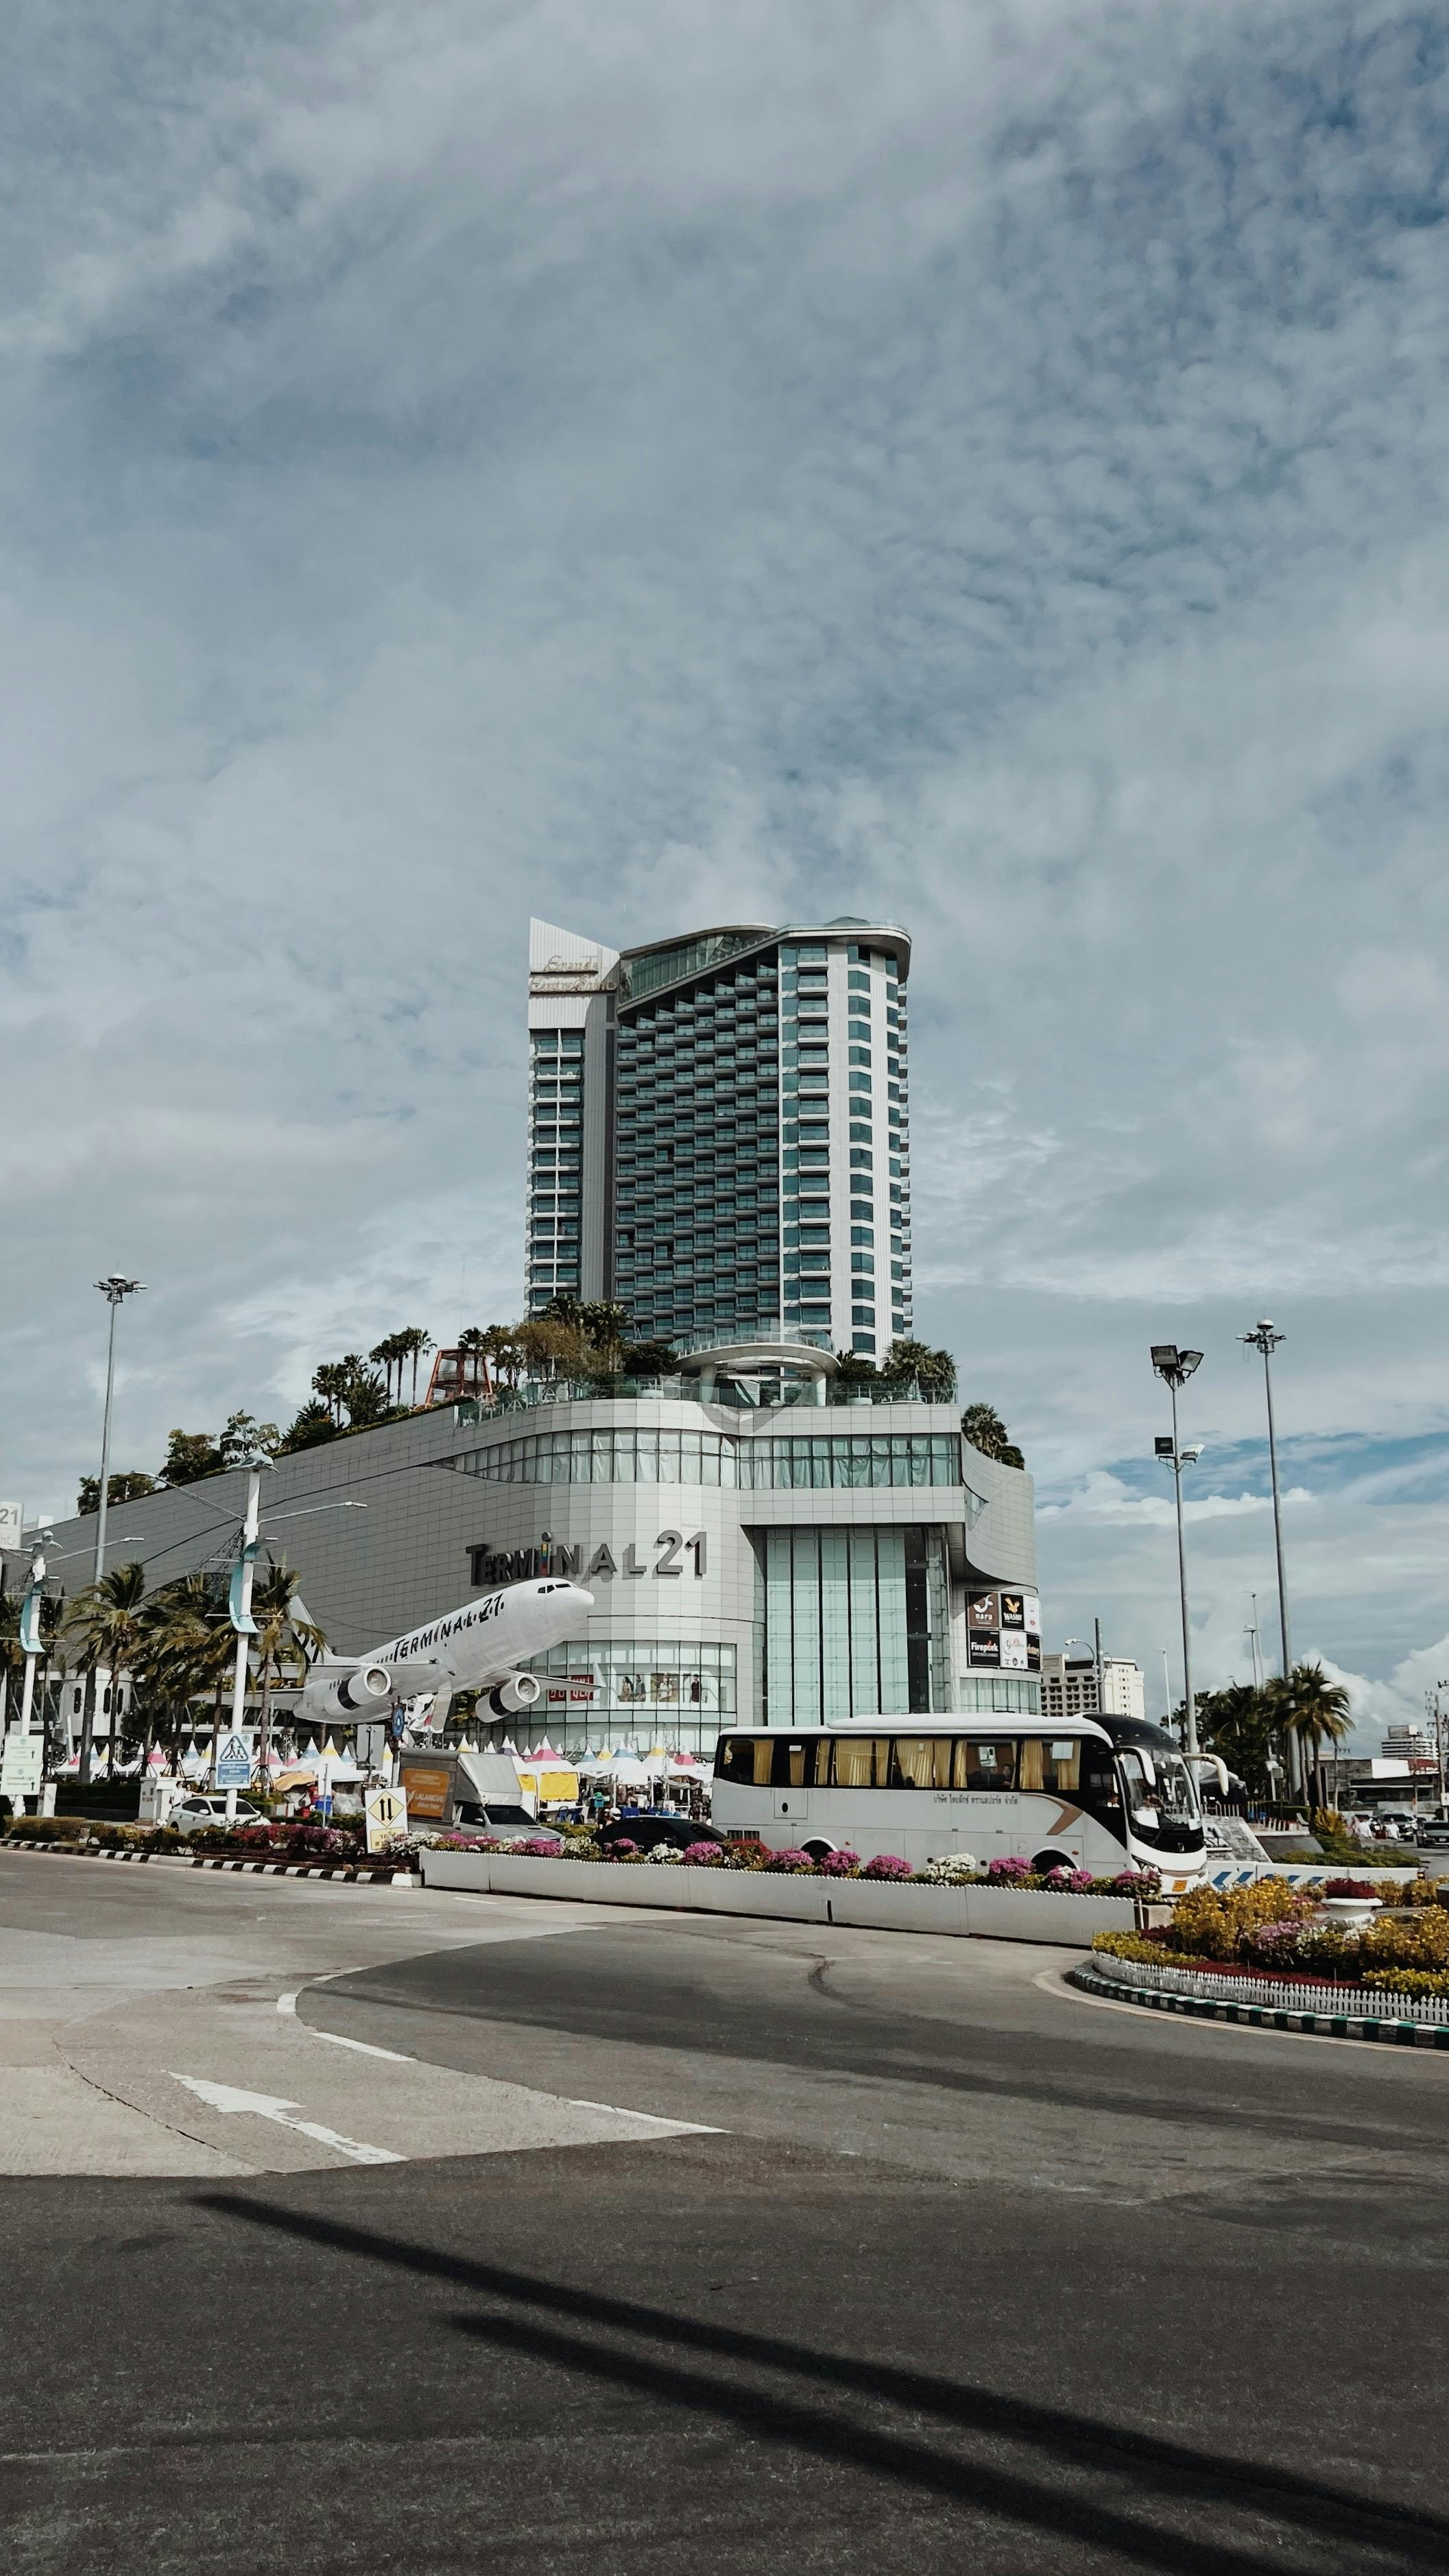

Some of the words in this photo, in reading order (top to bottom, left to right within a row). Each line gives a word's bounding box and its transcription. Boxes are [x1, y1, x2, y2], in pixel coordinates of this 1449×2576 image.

[0, 1508, 18, 1525] 21
[654, 1529, 707, 1575] 21
[479, 1593, 505, 1623] 21
[971, 1641, 999, 1653] Firepork
